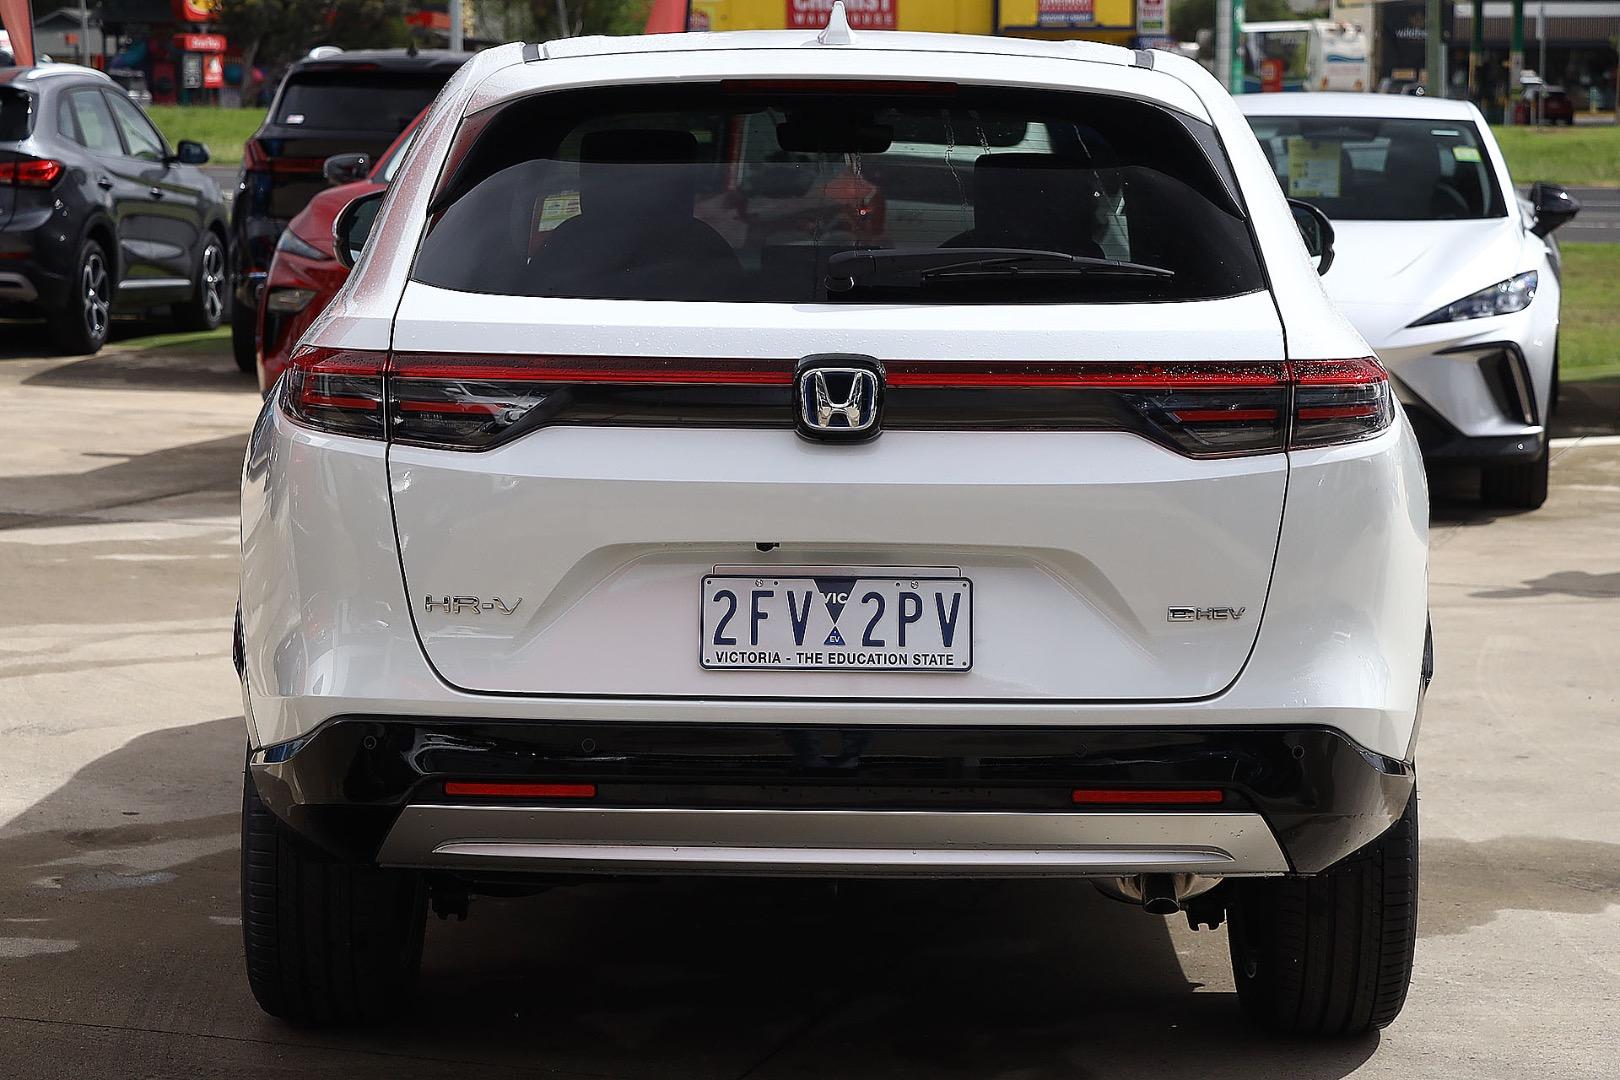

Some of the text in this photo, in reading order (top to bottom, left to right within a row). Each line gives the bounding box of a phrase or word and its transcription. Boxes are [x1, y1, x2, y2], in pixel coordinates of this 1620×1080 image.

[793, 12, 893, 25] WAROUSE
[424, 593, 523, 616] HR-V
[821, 592, 848, 604] VIC
[713, 589, 961, 648] 2FV 2PV
[829, 635, 841, 643] EV
[715, 651, 782, 664] VICTORIA
[796, 652, 823, 664] THE
[827, 652, 908, 665] EDUCATION
[912, 653, 954, 666] STATE
